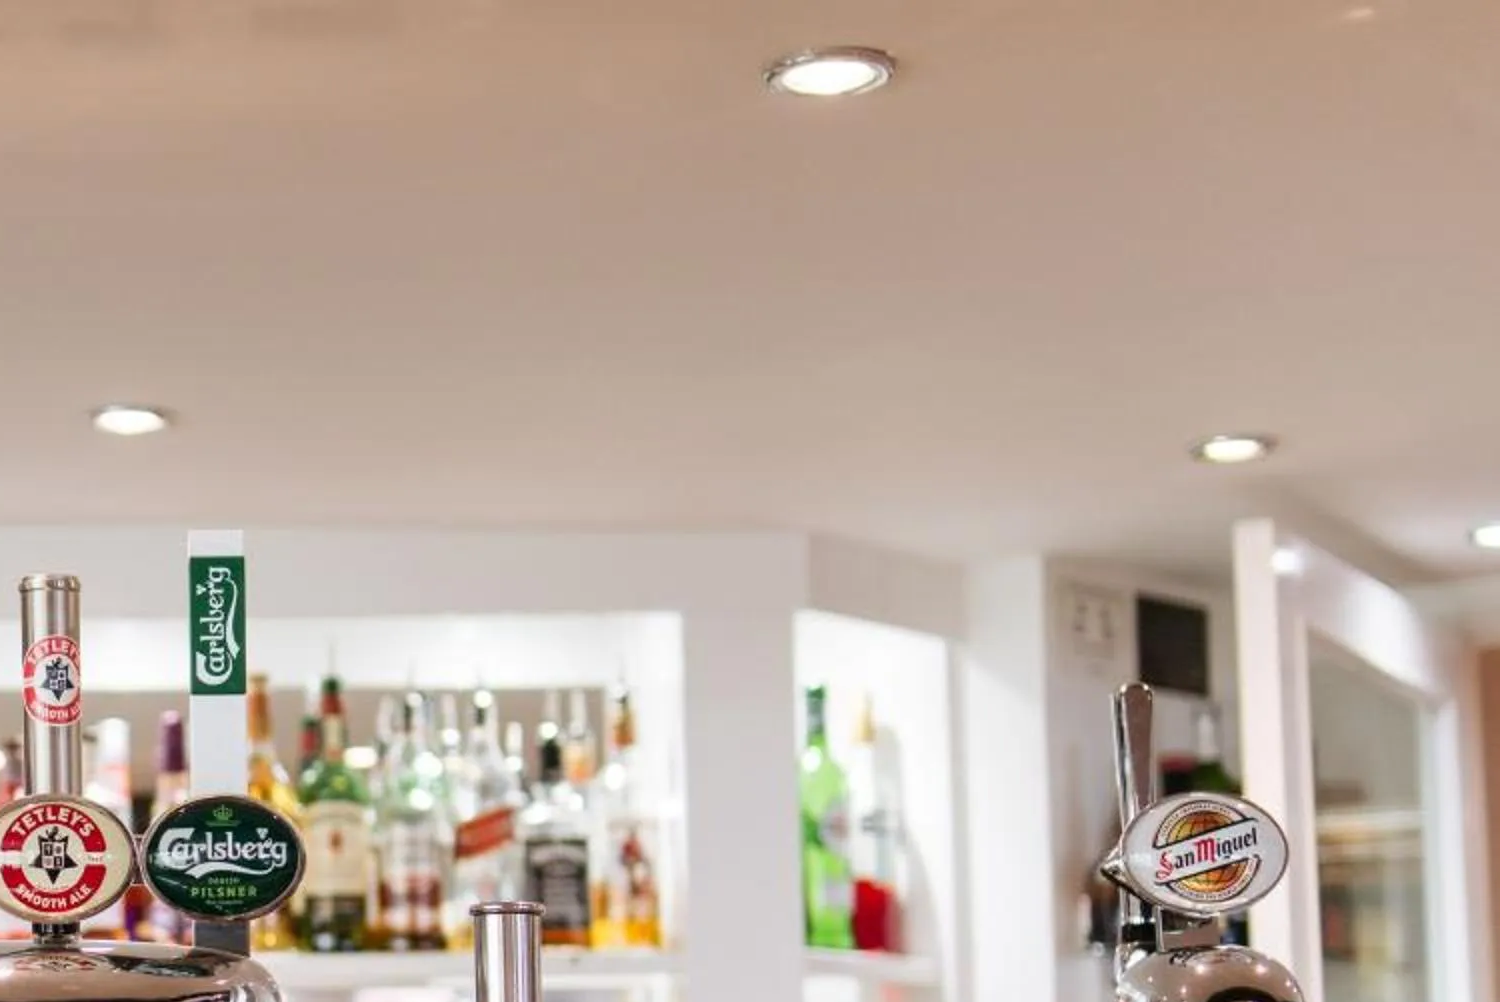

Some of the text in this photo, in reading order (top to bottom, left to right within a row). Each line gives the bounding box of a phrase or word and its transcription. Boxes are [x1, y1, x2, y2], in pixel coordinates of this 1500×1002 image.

[195, 565, 240, 686] Carlsberg
[11, 806, 95, 837] TETLEY'S
[157, 827, 288, 878] Carlsberg
[15, 884, 92, 908] SMOOTH ALE
[191, 886, 257, 898] PILSNER
